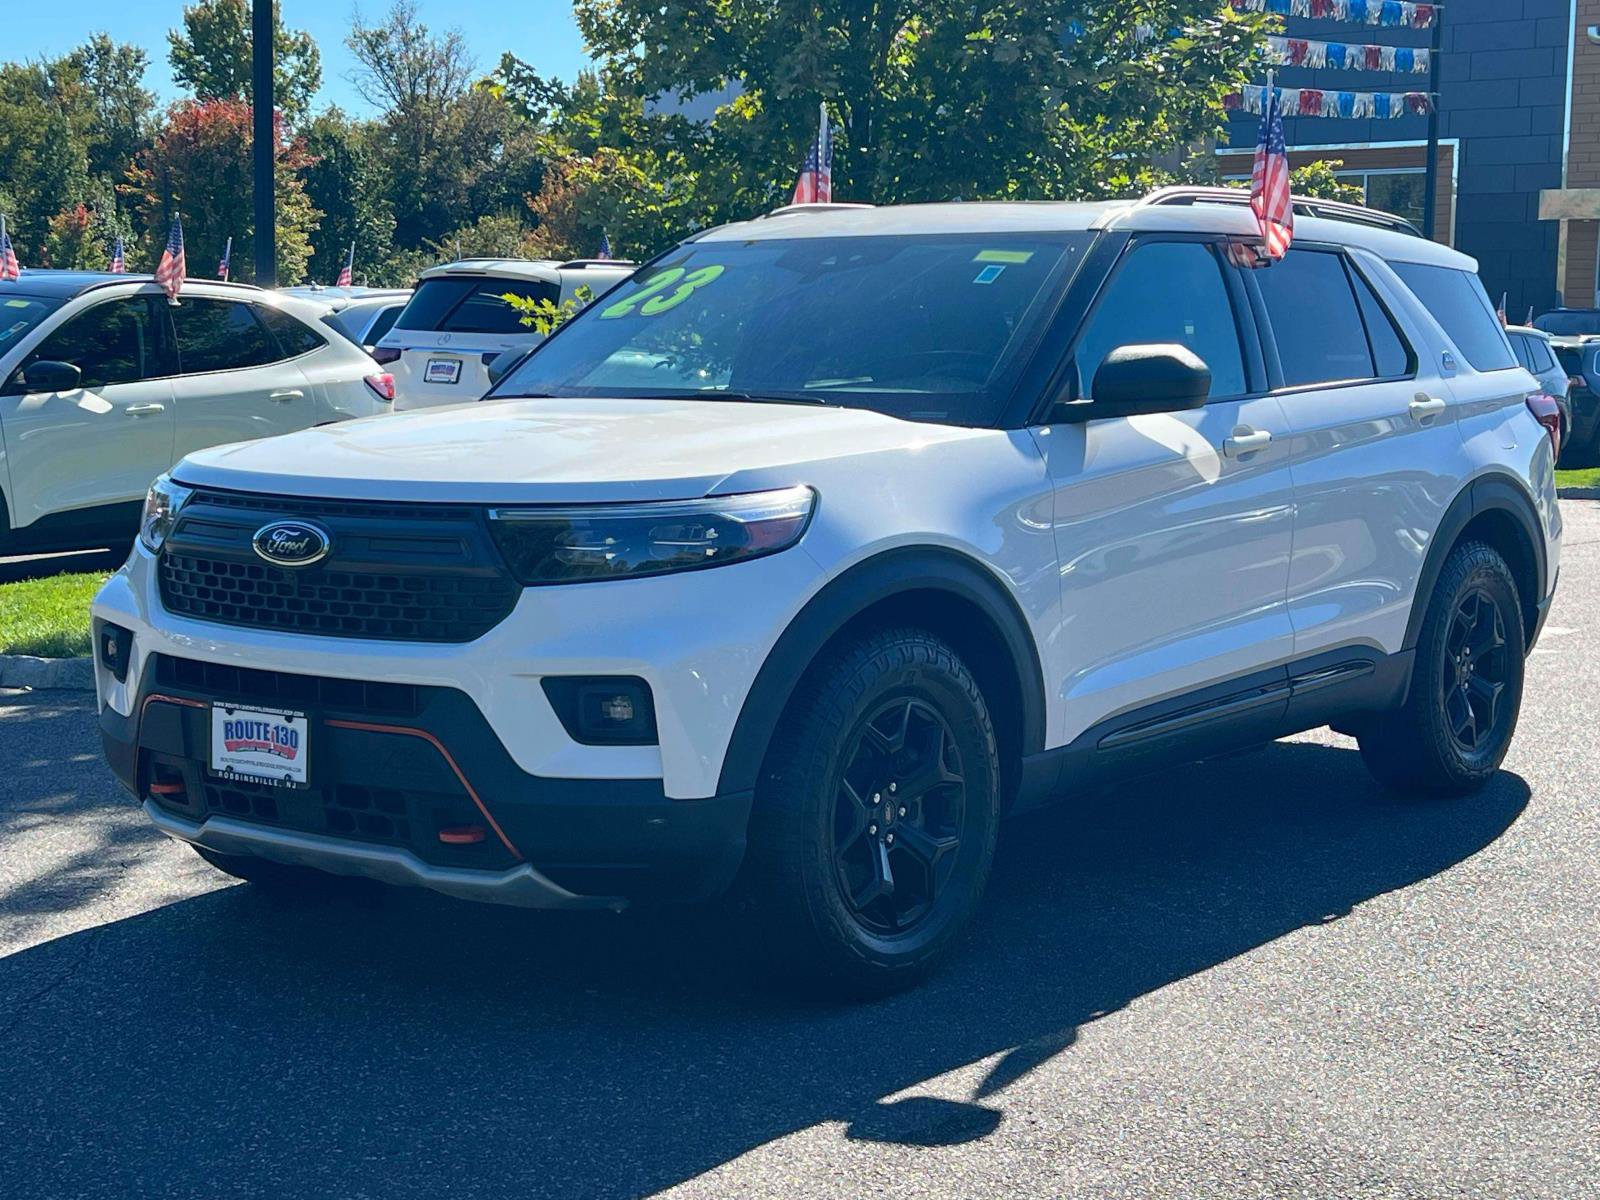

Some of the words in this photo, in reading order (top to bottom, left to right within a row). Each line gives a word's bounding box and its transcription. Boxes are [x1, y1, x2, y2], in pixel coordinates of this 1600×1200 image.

[600, 264, 725, 320] 23
[267, 529, 310, 555] Ford
[224, 720, 271, 741] ROUTE
[273, 725, 299, 749] 130
[286, 781, 297, 789] NJ
